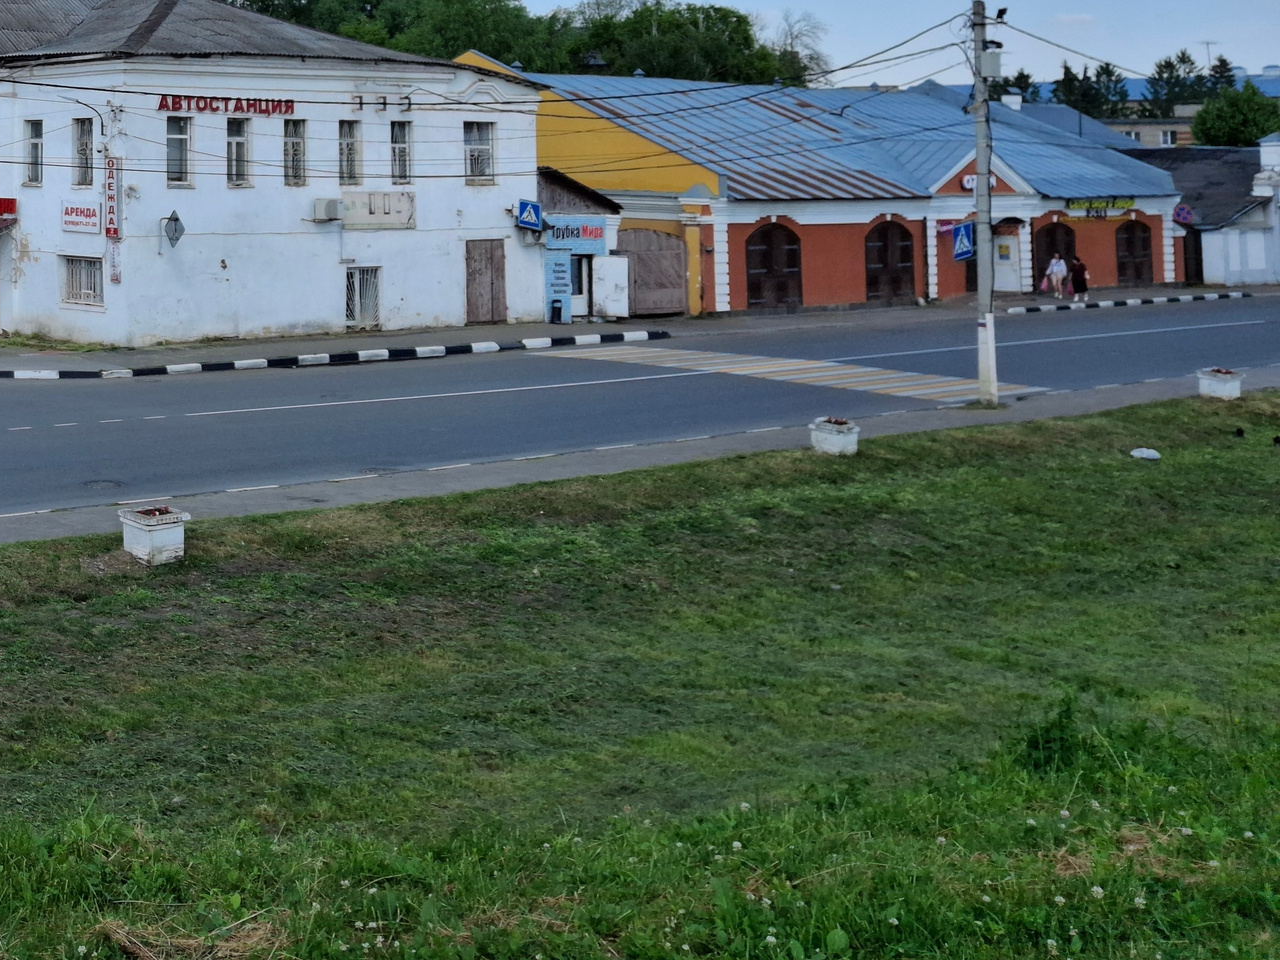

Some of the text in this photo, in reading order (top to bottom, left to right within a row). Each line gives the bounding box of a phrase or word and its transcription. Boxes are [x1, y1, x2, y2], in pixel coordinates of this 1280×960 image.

[157, 95, 295, 117] АВТОСТАНЦИЯ
[107, 159, 115, 226] ОДЕЖДА
[64, 206, 97, 219] АРЕНДА
[551, 224, 603, 240] Трубка Мира
